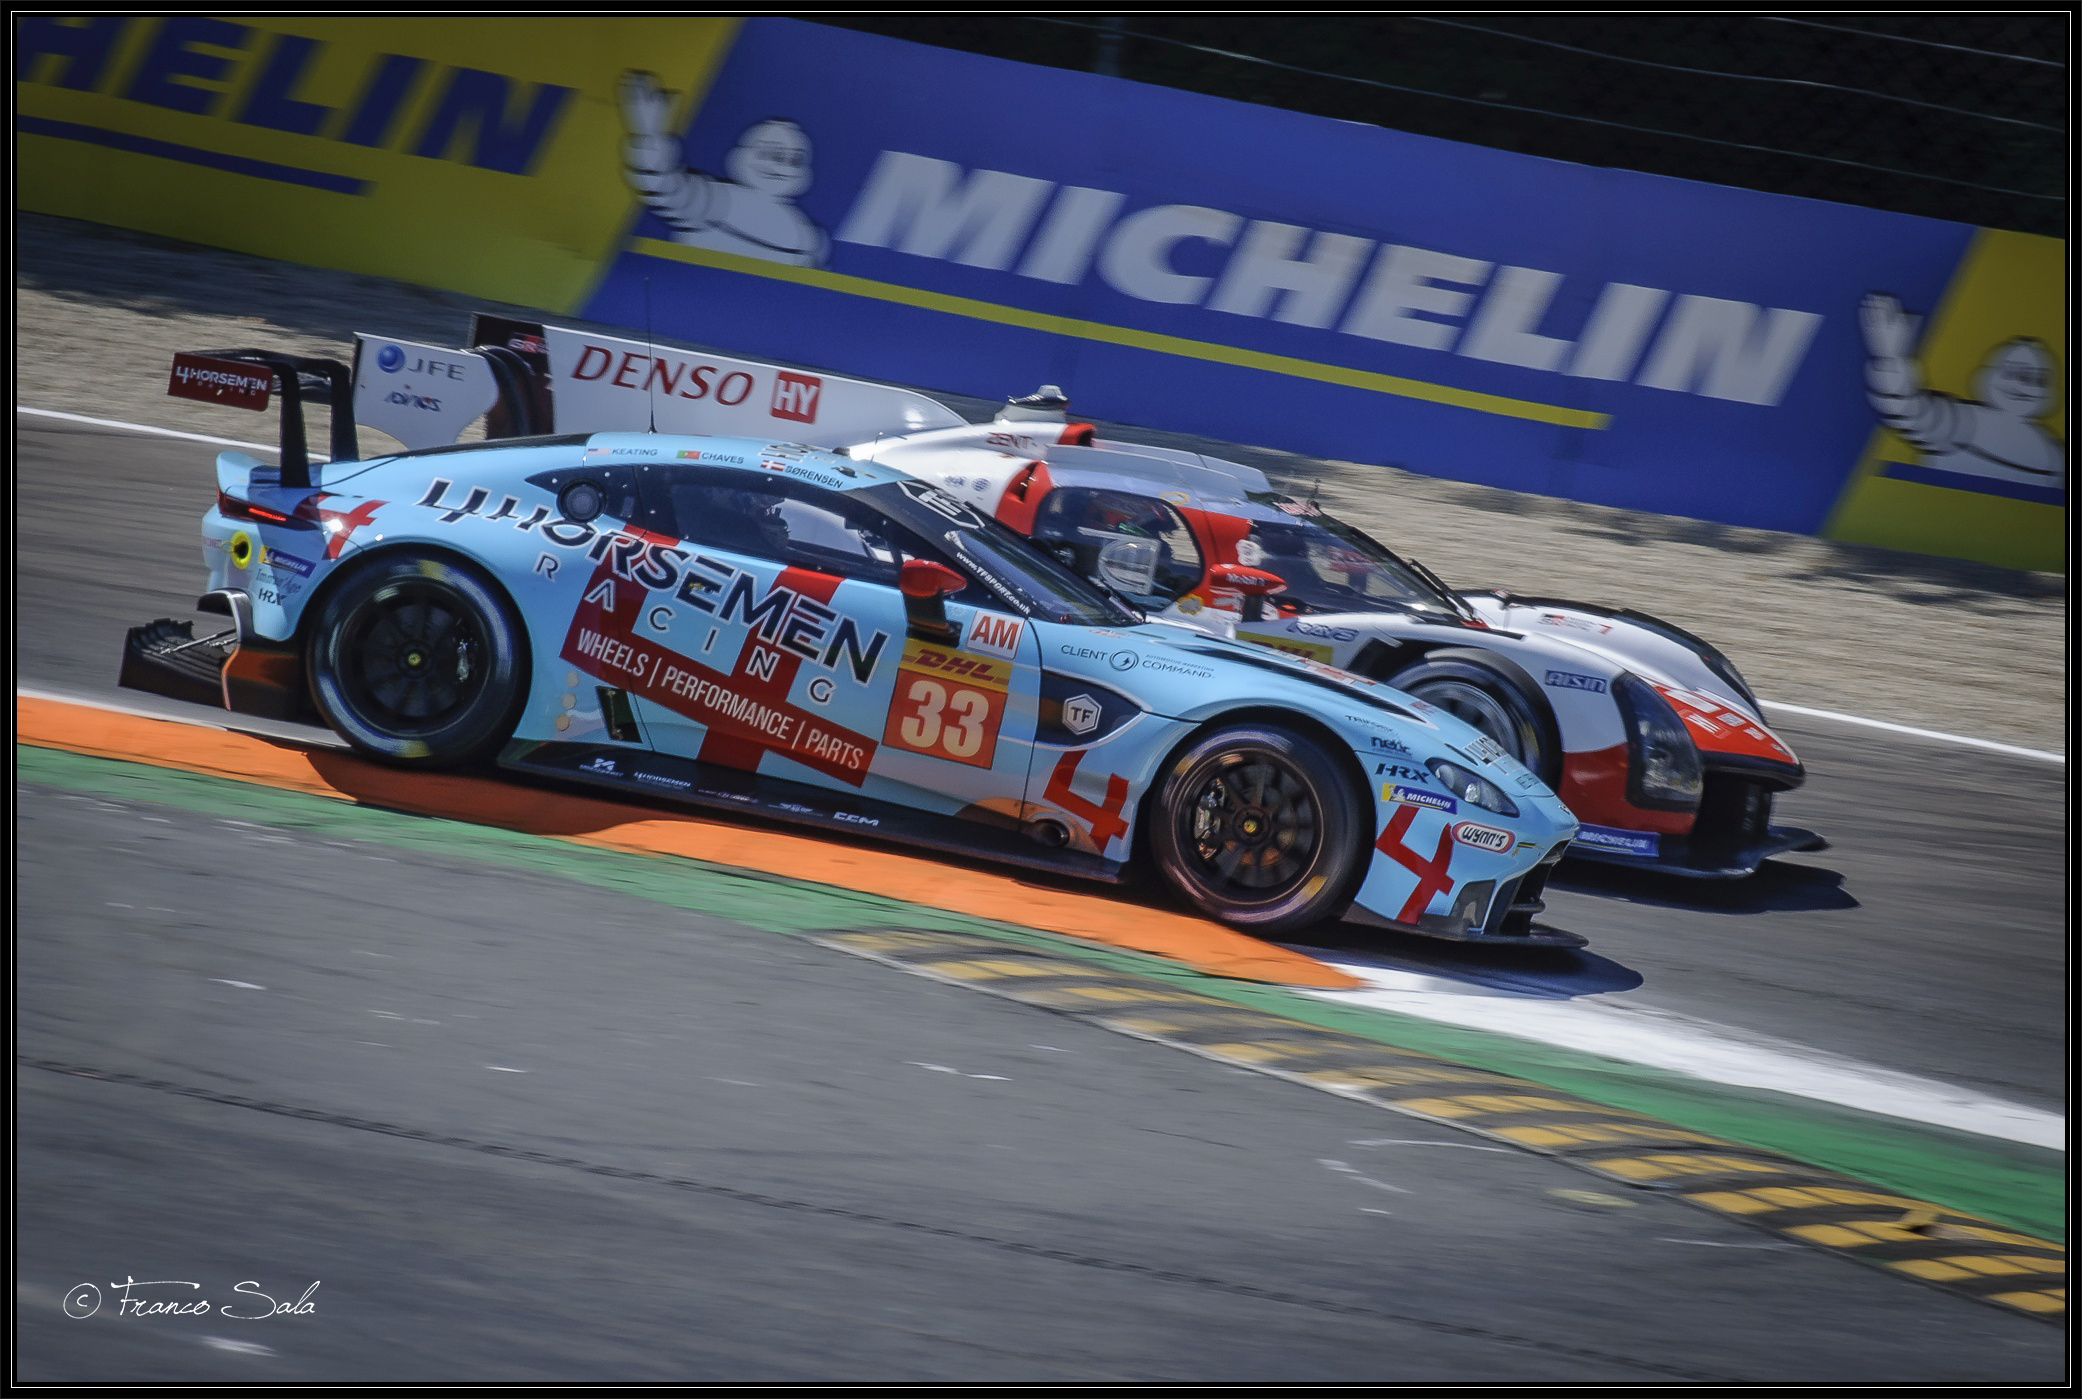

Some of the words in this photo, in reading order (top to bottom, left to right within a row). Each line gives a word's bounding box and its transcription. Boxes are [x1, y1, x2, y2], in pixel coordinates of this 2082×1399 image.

[834, 150, 1824, 406] MICHELIN
[407, 358, 465, 381] JFE
[571, 344, 755, 406] DENSO
[771, 379, 819, 416] HY
[611, 448, 658, 457] KEATING
[701, 452, 744, 464] CHAVES
[785, 465, 843, 488] SØRENSEN
[413, 478, 890, 686] 4HORSEMEN
[534, 552, 836, 705] RACING
[970, 615, 1020, 650] AM
[911, 650, 996, 682] DHL
[1061, 645, 1108, 661] CLIENT
[1142, 660, 1212, 678] COMMAND
[576, 628, 649, 677] WHEELS
[660, 665, 795, 740] PERFORMANCE
[805, 729, 864, 771] PARTS
[1070, 705, 1094, 724] TF
[900, 680, 989, 758] 33
[1375, 763, 1430, 785] HRX
[1406, 793, 1452, 810] MICHELIN
